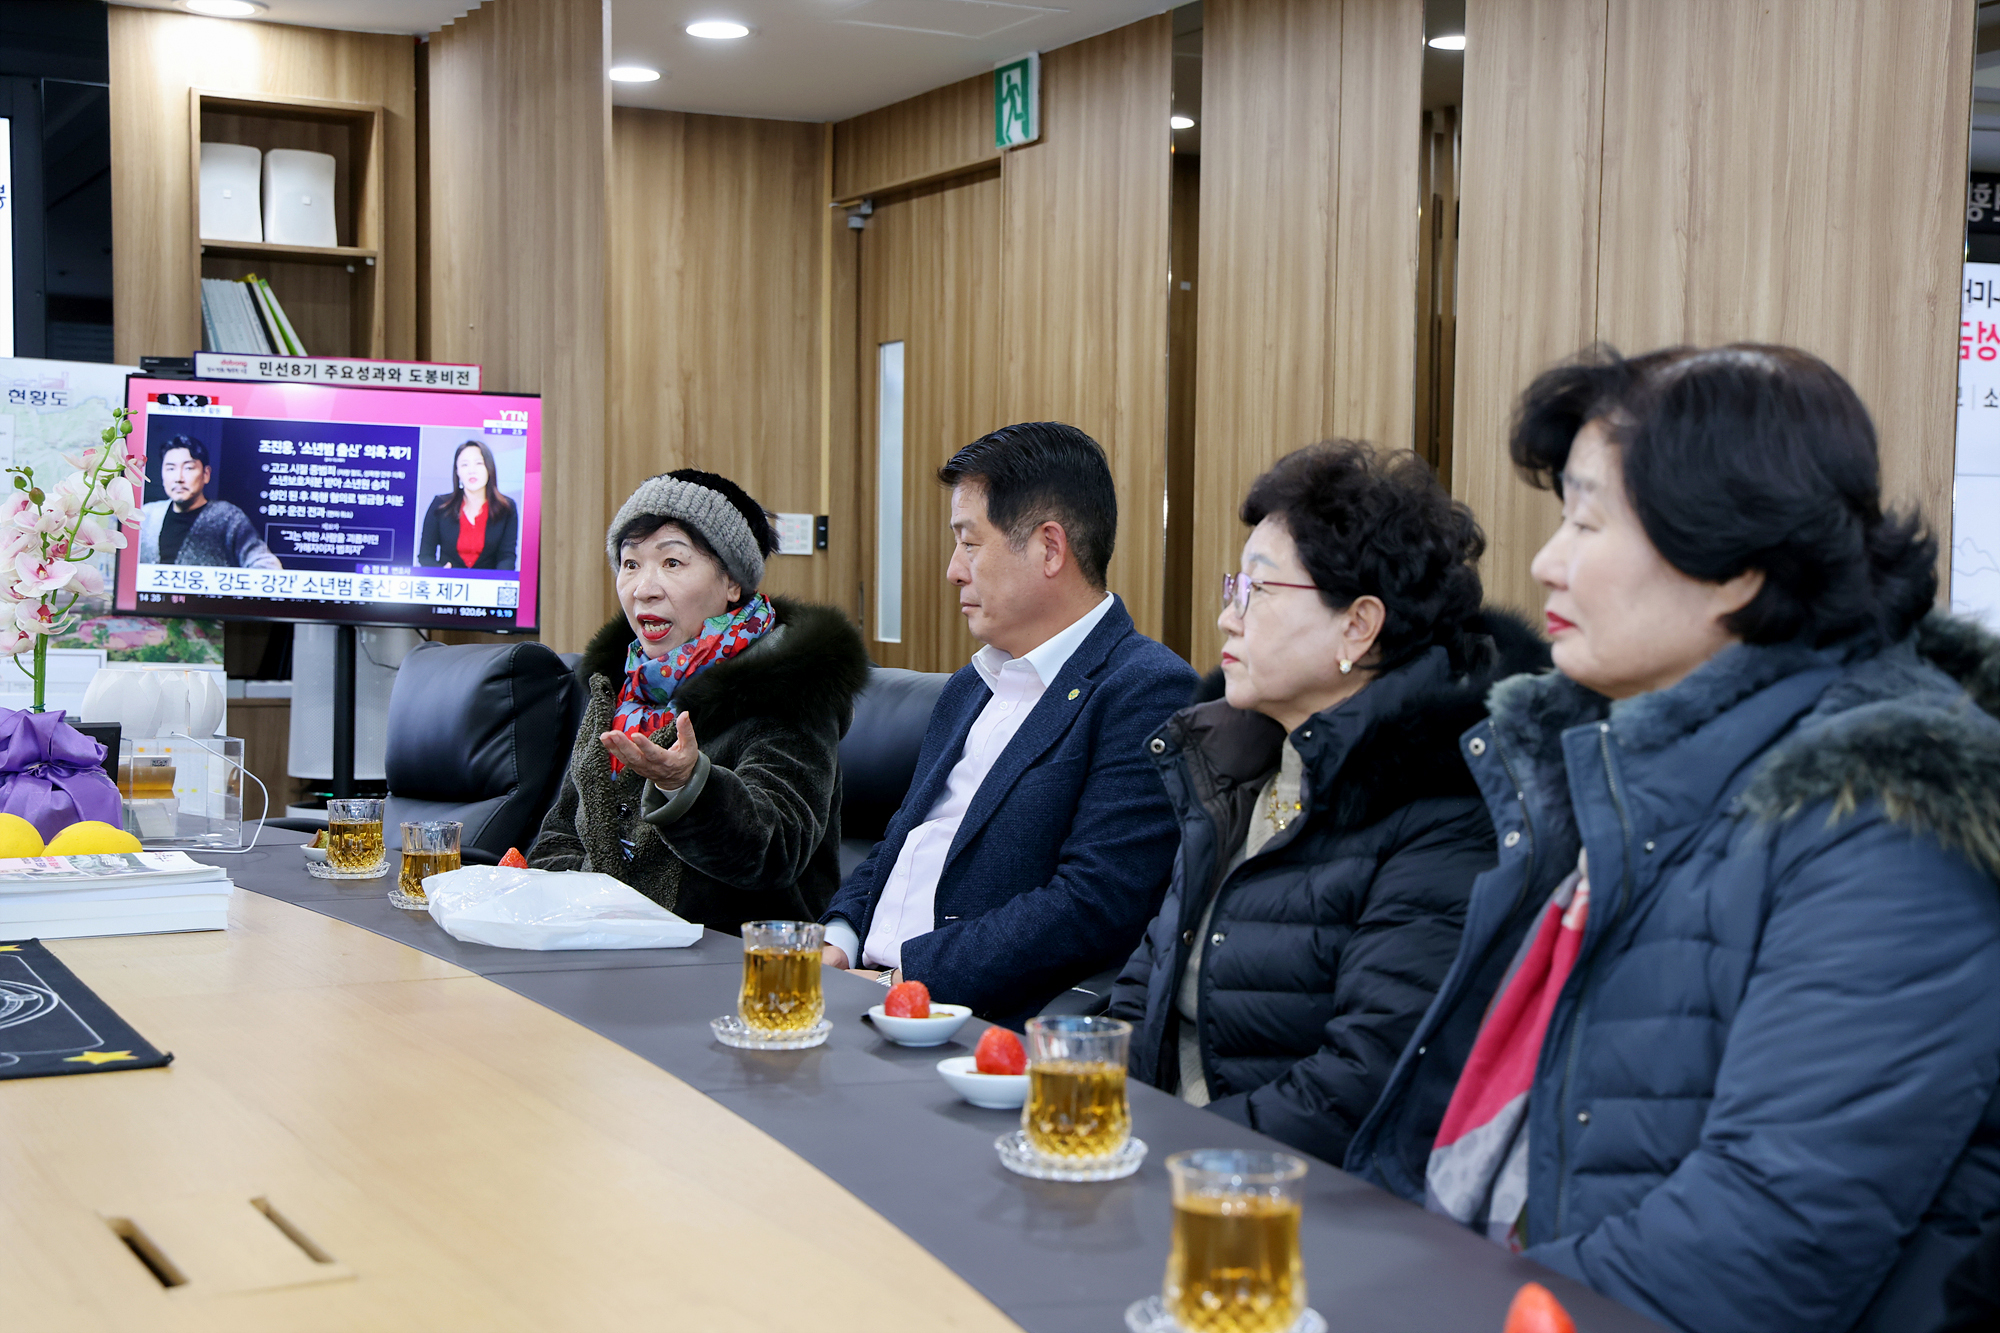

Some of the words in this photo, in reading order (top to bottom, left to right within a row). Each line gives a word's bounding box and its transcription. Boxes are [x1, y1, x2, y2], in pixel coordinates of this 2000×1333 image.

[260, 361, 316, 378] 민선8기
[324, 364, 402, 382] 주요성과와
[409, 368, 470, 386] 도봉비전
[8, 388, 68, 407] 현황도
[500, 410, 528, 422] YTN
[258, 440, 296, 456] 조진웅,
[363, 444, 387, 459] 의혹
[388, 446, 412, 460] 제기
[270, 462, 289, 474] 고교
[290, 463, 308, 476] 시절
[309, 464, 336, 476] 중범죄
[268, 474, 323, 488] 소년보호처분
[323, 477, 342, 489] 받아
[342, 478, 370, 490] 소년원
[371, 479, 390, 491] 송치
[268, 490, 288, 502] 성인
[288, 490, 298, 502] 된
[299, 490, 309, 502] 후
[309, 490, 329, 503] 폭행
[330, 492, 357, 504] 혐의로
[357, 493, 384, 506] 벌금형
[385, 494, 404, 507] 처분
[268, 504, 287, 517] 음주
[287, 504, 306, 518] 운전
[307, 506, 326, 518] 전과
[302, 531, 320, 543] 약한
[320, 532, 346, 544] 사람을
[346, 533, 379, 545] 괴롭히던
[293, 542, 336, 554] 가해자이자
[152, 570, 208, 592] 조진웅,
[214, 570, 298, 594] '강도·강간'
[302, 576, 352, 596] 소년범
[358, 578, 392, 598] 출신
[398, 580, 430, 600] 의혹
[436, 582, 470, 602] 제기
[460, 607, 486, 618] 920.64
